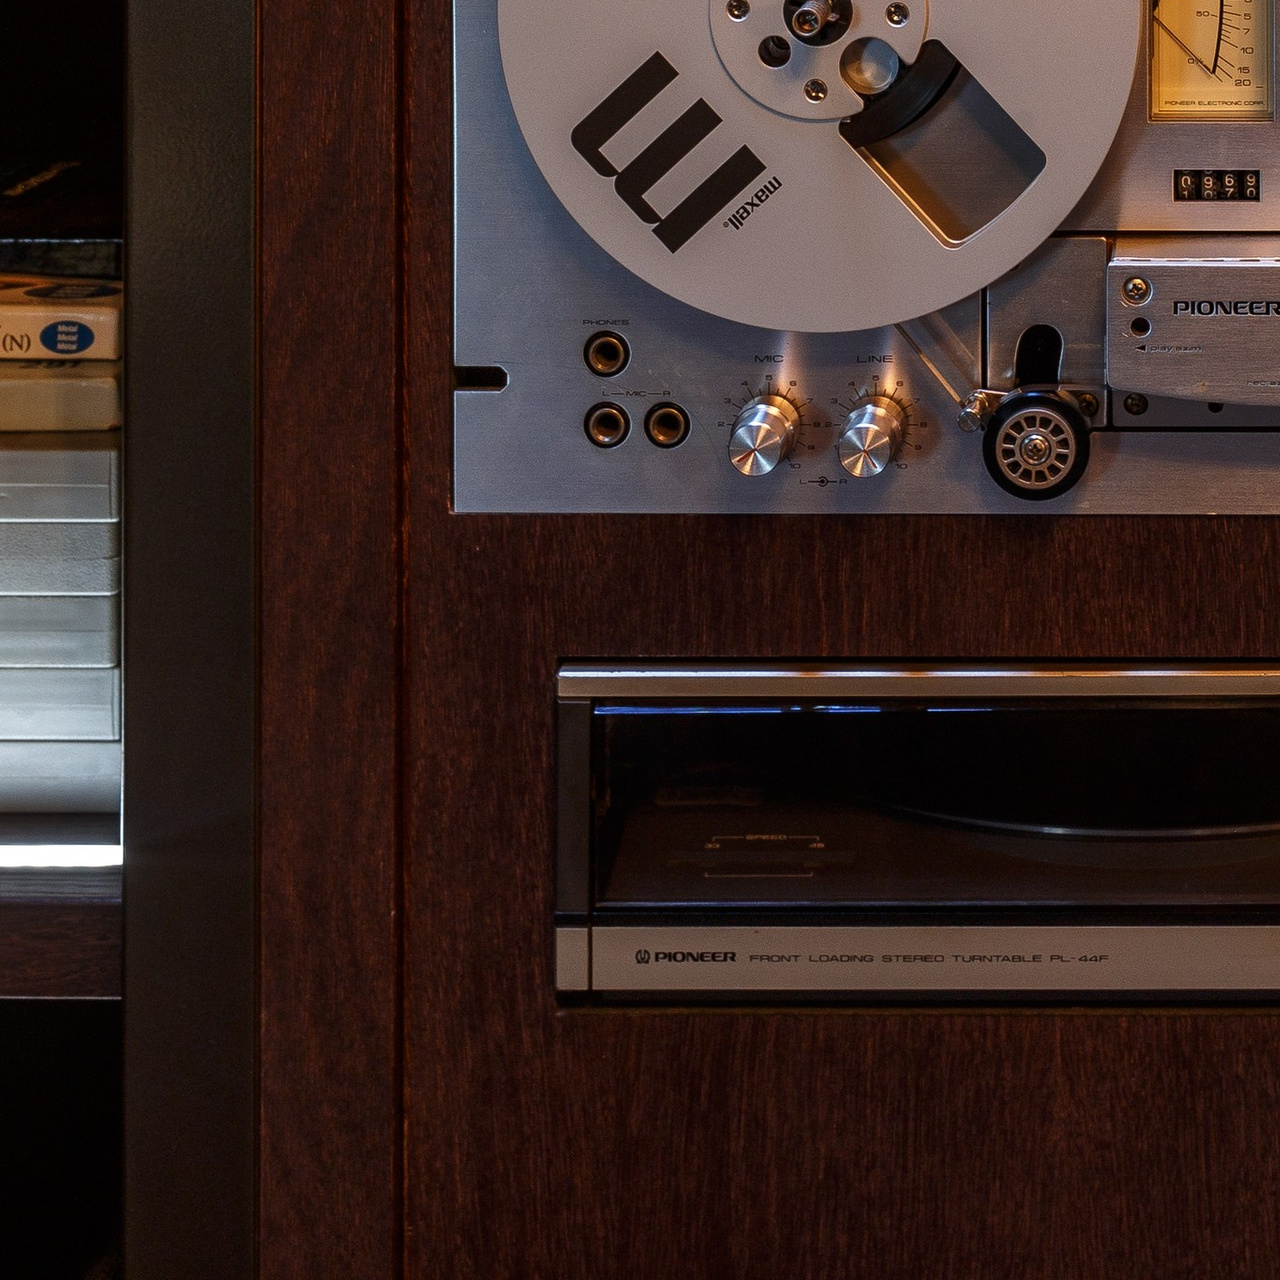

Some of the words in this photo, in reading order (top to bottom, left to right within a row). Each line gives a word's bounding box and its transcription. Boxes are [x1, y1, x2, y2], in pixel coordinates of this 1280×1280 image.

[728, 176, 783, 230] maxell
[1150, 344, 1173, 354] play
[754, 355, 784, 363] MIC
[857, 355, 893, 363] LINE
[655, 951, 736, 963] PIONEER
[750, 955, 800, 963] FRONT
[809, 955, 874, 963] LOADING
[882, 955, 945, 963] STEREO
[952, 954, 1042, 963] TURNTABLE
[1050, 954, 1109, 963] PL-44F
